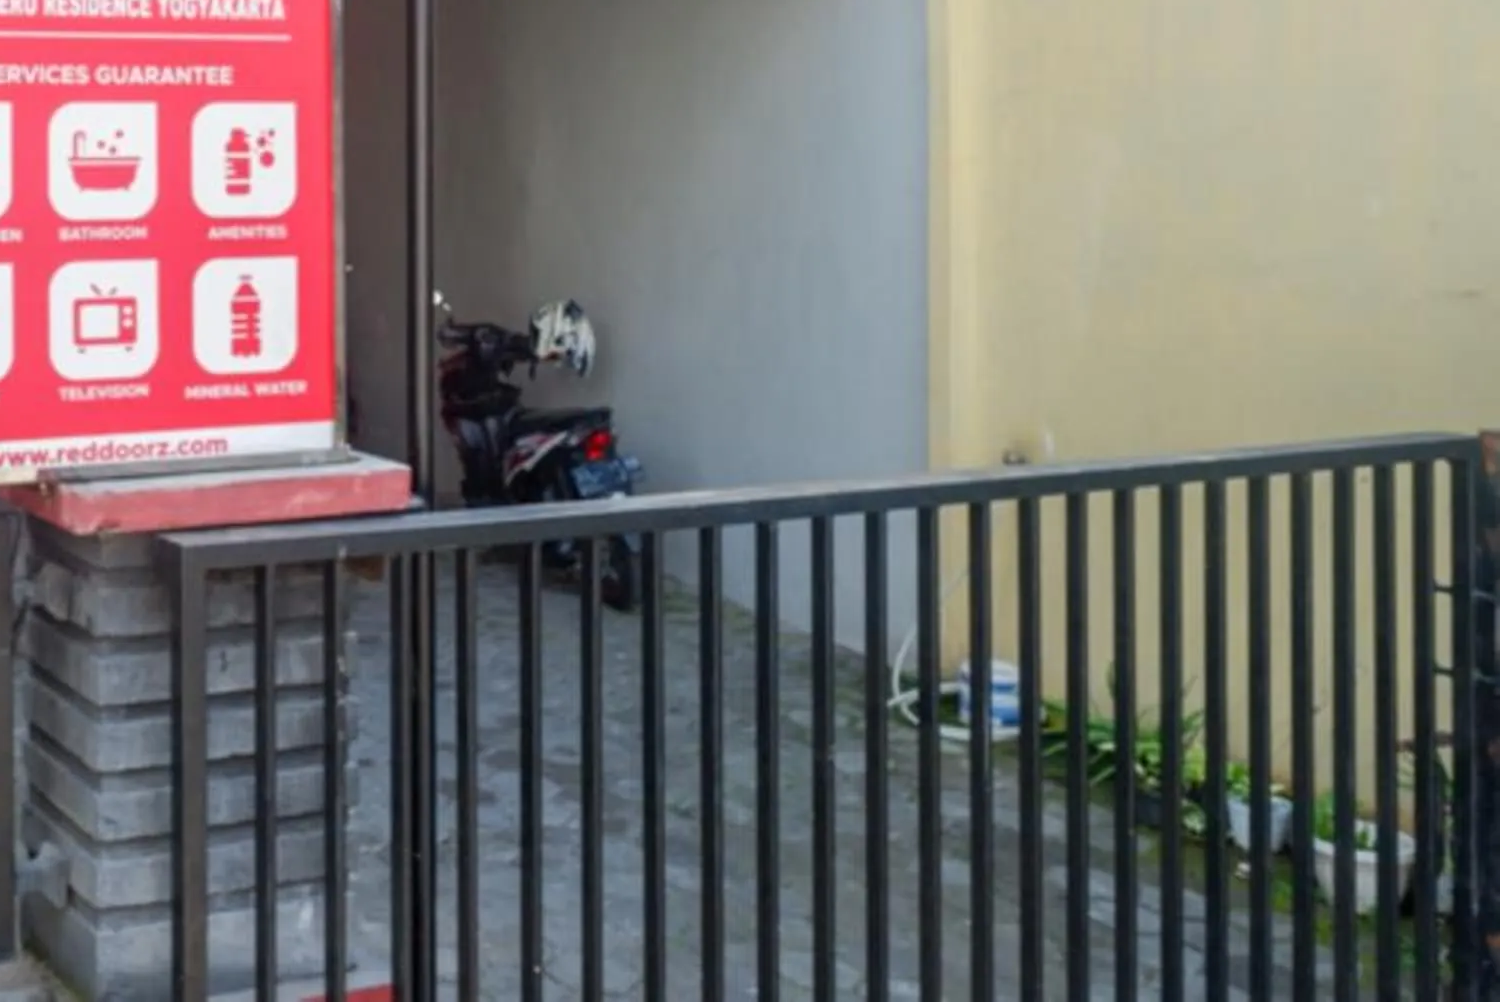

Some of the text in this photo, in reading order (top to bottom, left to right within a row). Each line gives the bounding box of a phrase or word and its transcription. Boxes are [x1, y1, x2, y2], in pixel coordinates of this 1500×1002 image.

[94, 65, 235, 86] GUARANTEE
[58, 226, 149, 242] BATHROOM
[58, 384, 151, 402] TELEVISION
[184, 380, 308, 400] MINERAL WATER
